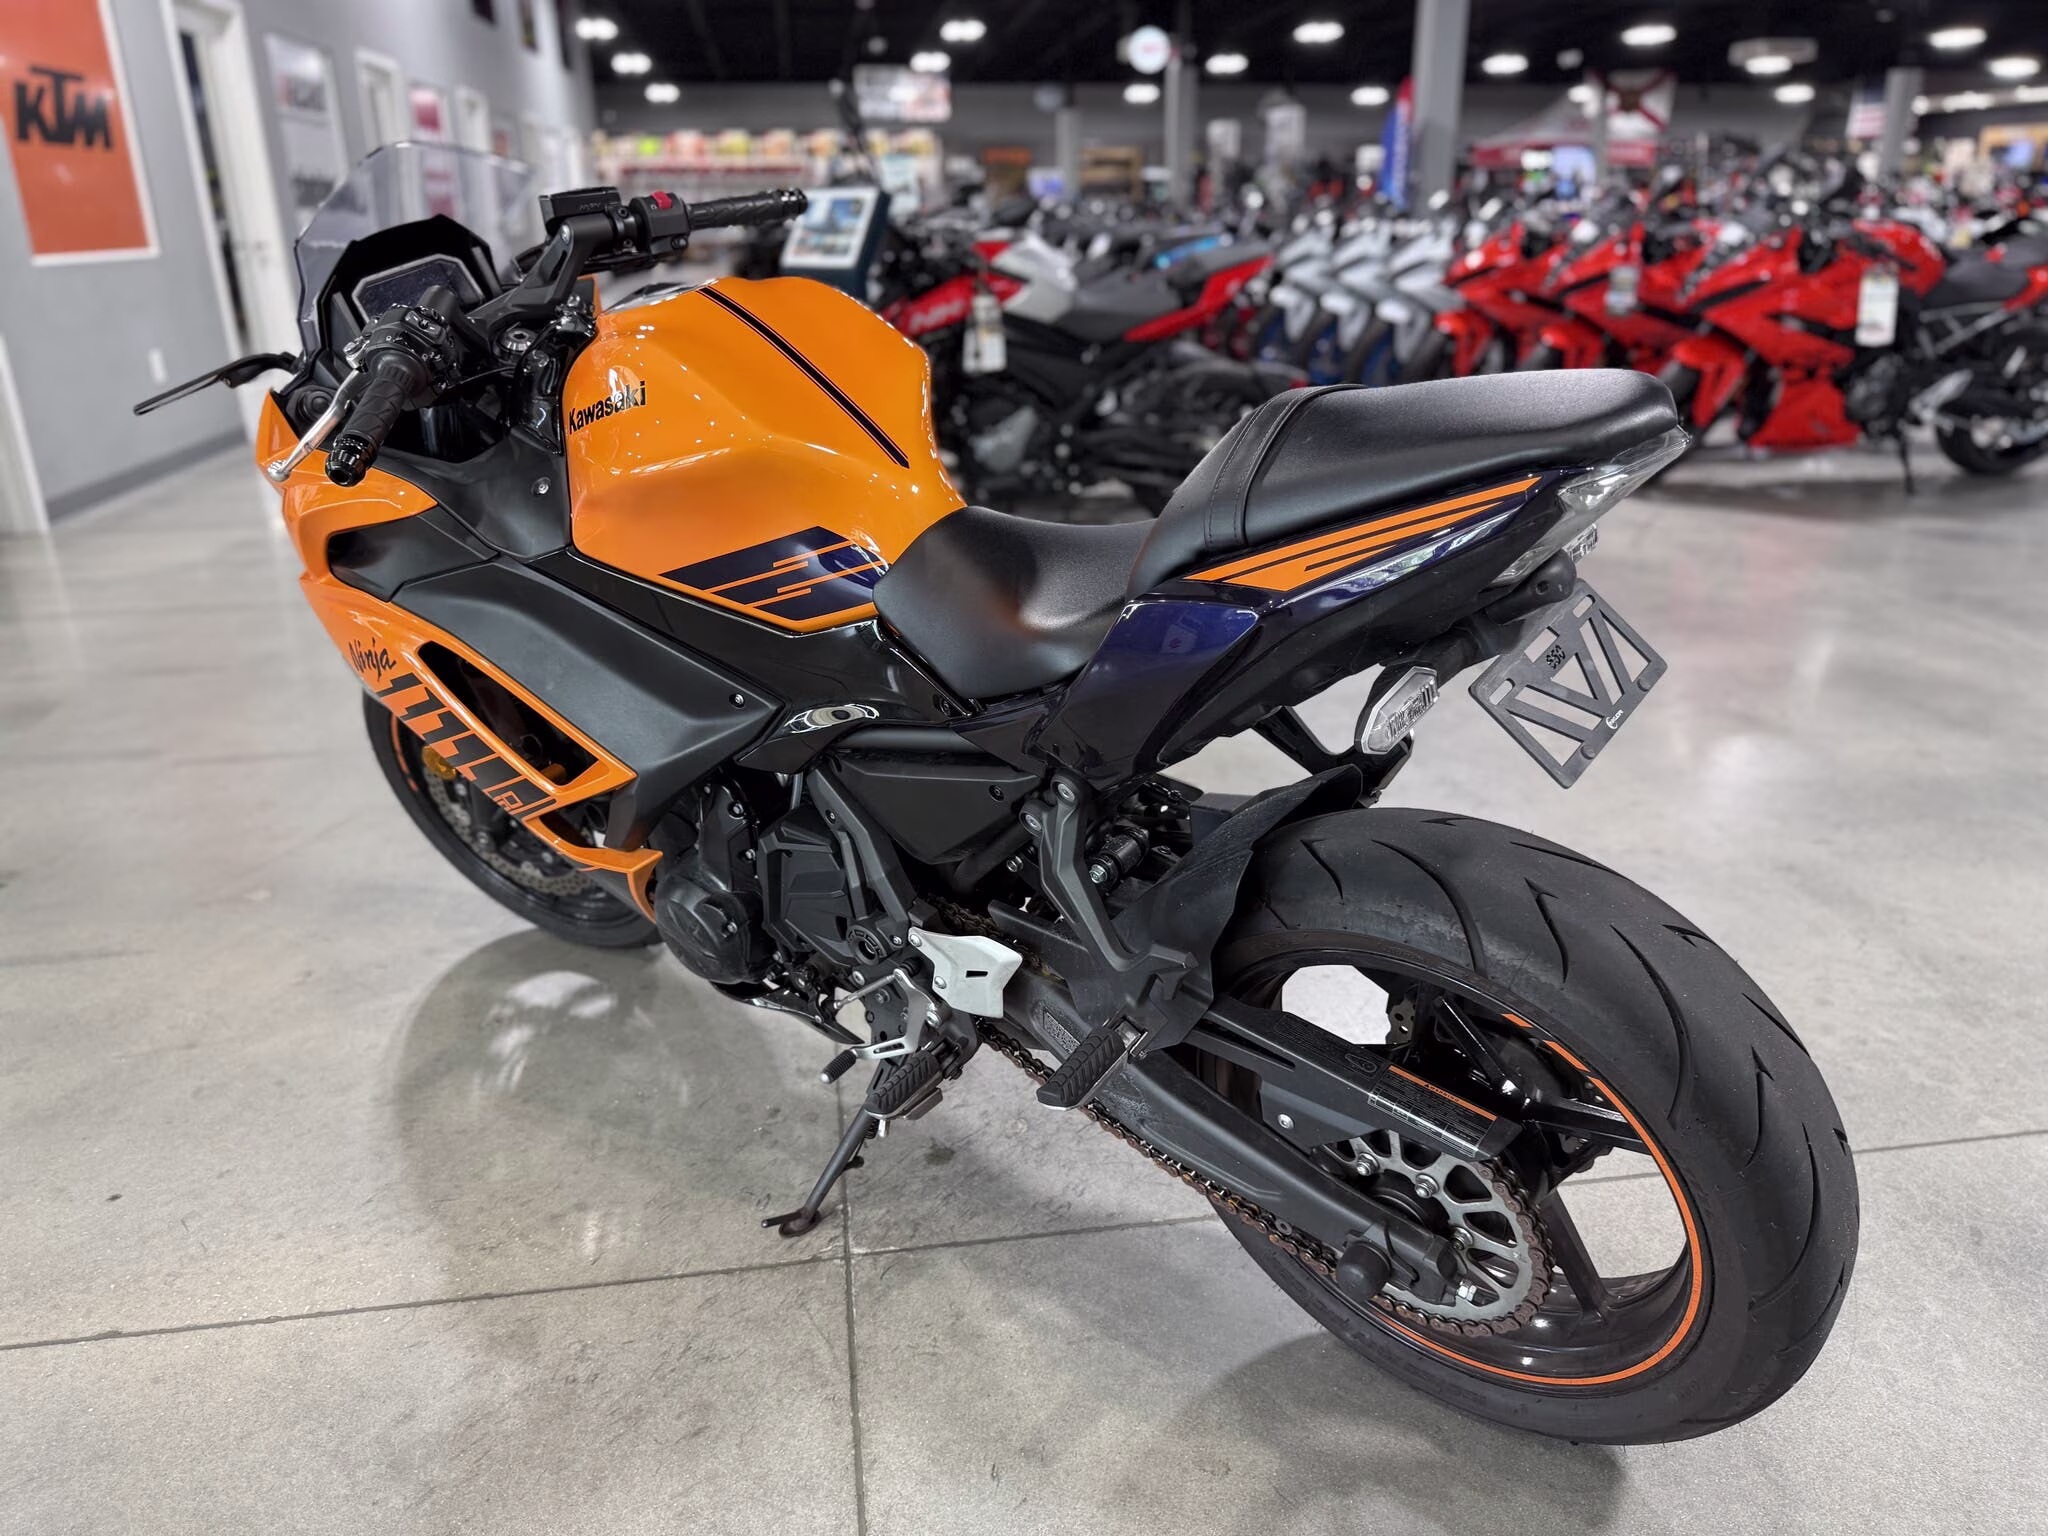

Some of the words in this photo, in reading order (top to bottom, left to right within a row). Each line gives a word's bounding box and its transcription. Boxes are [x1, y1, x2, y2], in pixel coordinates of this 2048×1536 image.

[15, 66, 113, 150] KTM
[568, 380, 646, 435] Kawasaki
[348, 636, 397, 682] Ninja
